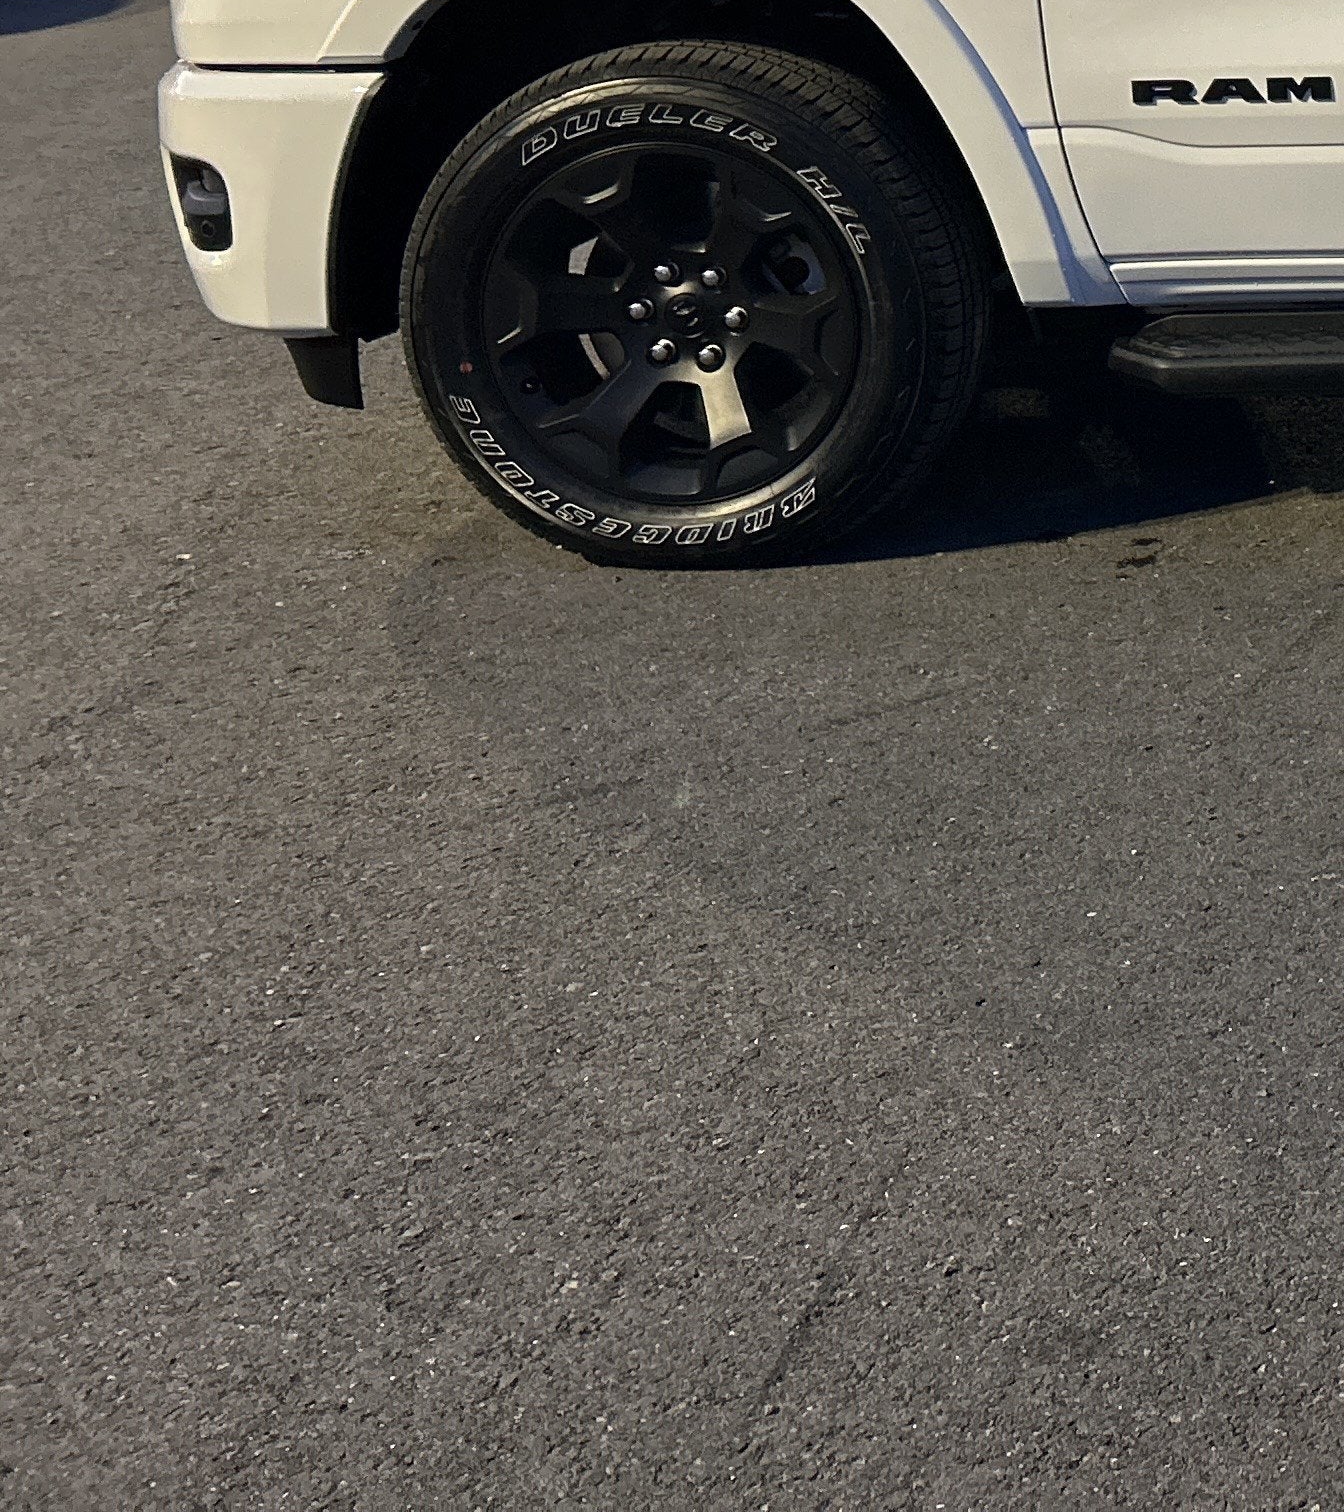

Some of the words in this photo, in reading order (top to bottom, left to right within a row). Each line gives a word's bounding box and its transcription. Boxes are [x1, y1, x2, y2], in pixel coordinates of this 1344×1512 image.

[1131, 76, 1336, 107] RAM
[520, 103, 779, 168] DUELER
[796, 165, 870, 255] H/L
[448, 394, 818, 547] BRIDGESTONE
